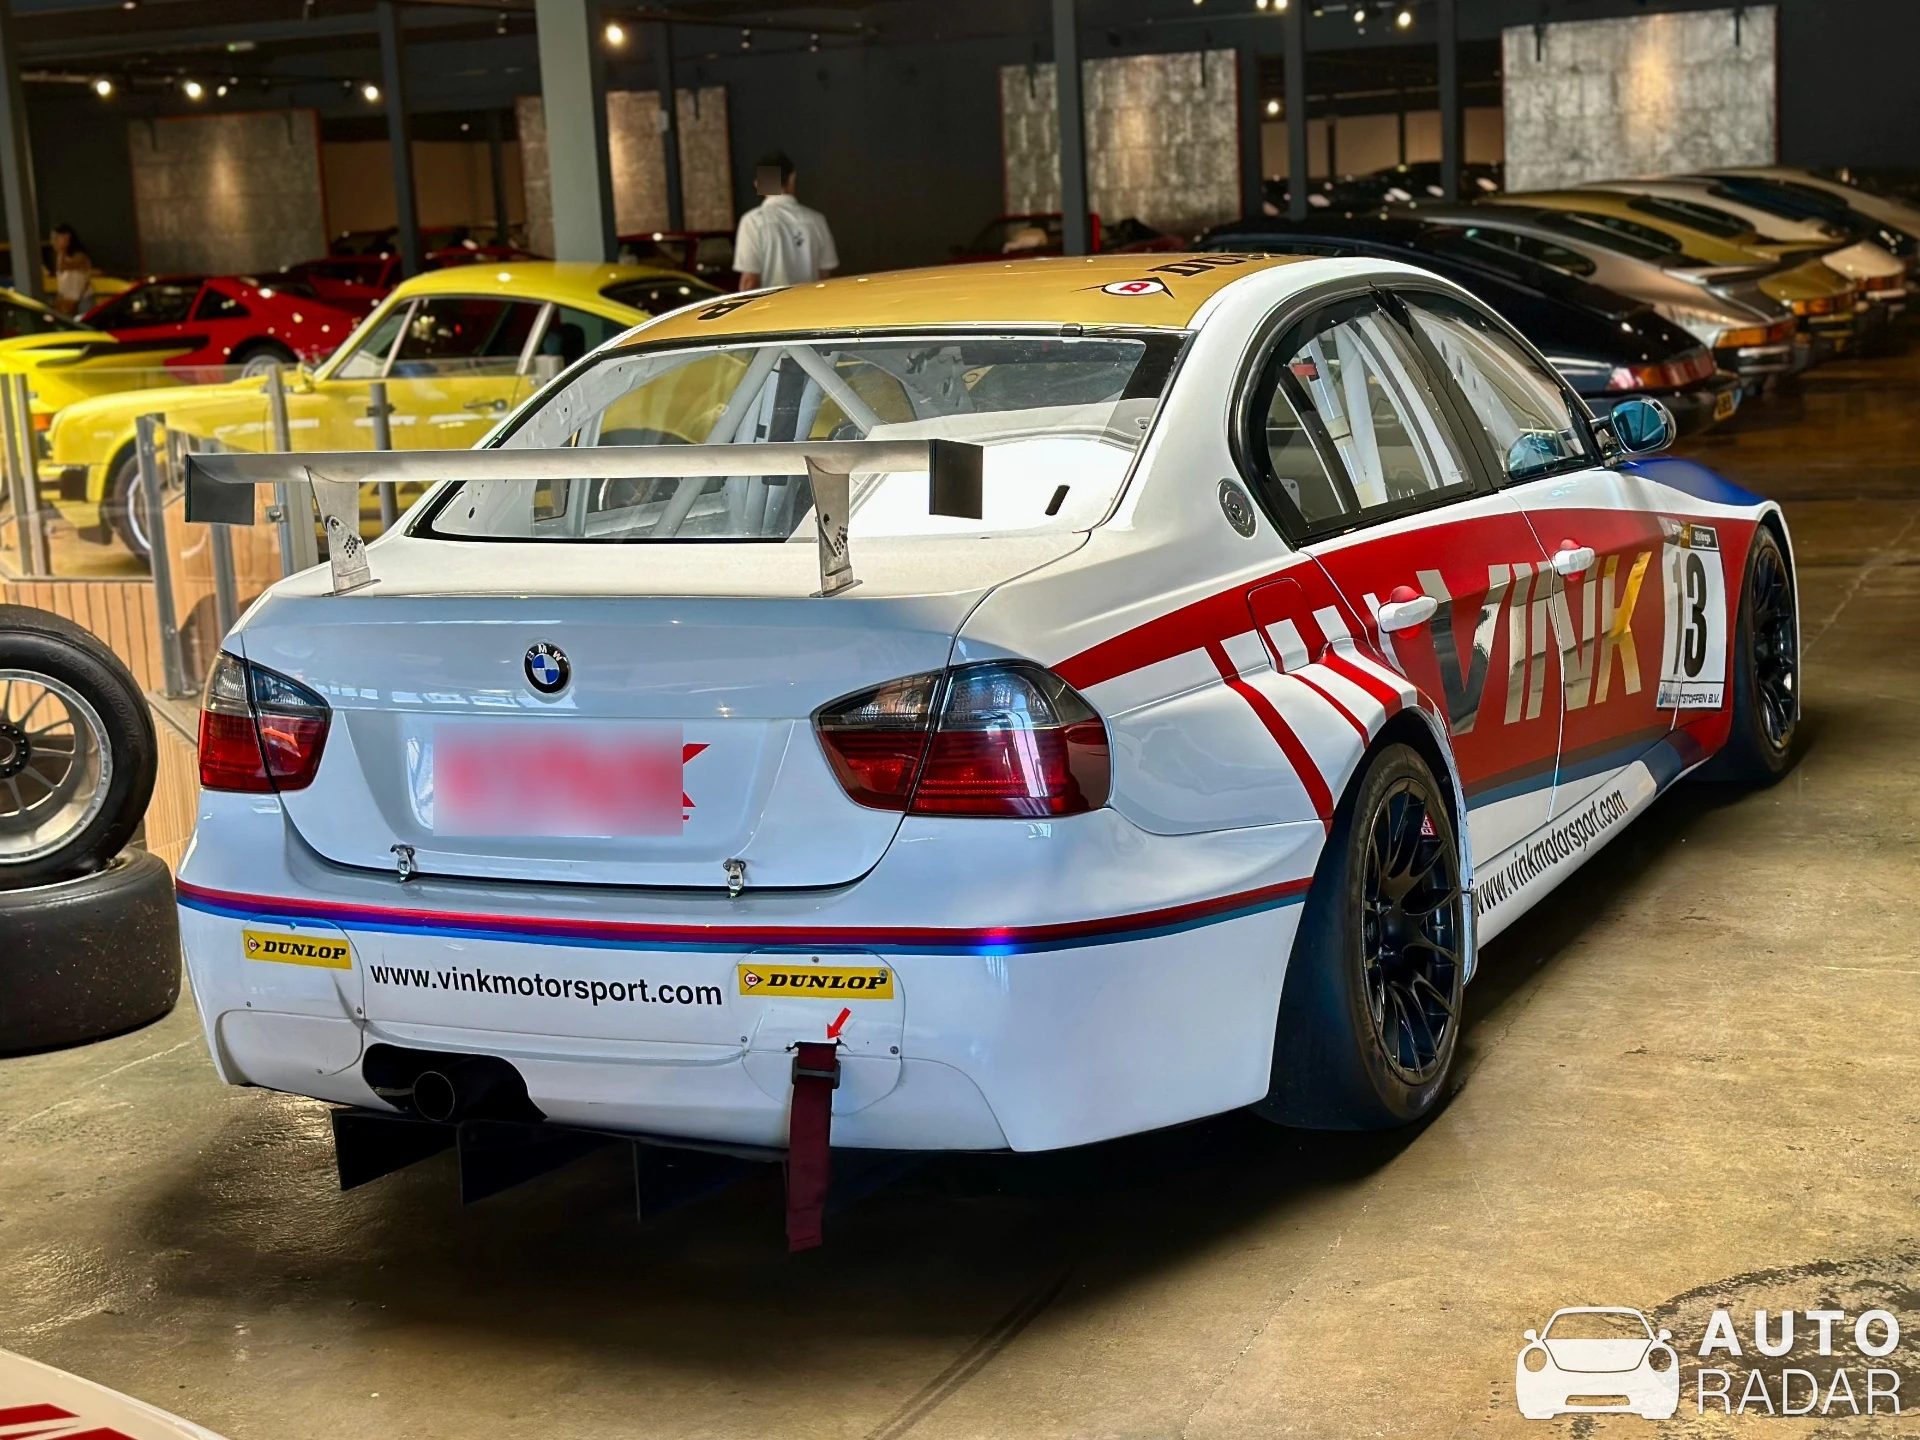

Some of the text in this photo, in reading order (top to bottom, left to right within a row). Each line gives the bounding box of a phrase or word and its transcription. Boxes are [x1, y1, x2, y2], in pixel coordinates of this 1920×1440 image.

[1672, 552, 1707, 678] 13
[527, 643, 567, 662] BMW
[1416, 551, 1652, 737] VINK
[263, 940, 347, 960] DUNLOP
[370, 965, 723, 1006] www.vinkmotorsport.com
[767, 973, 888, 990] DUNLOP
